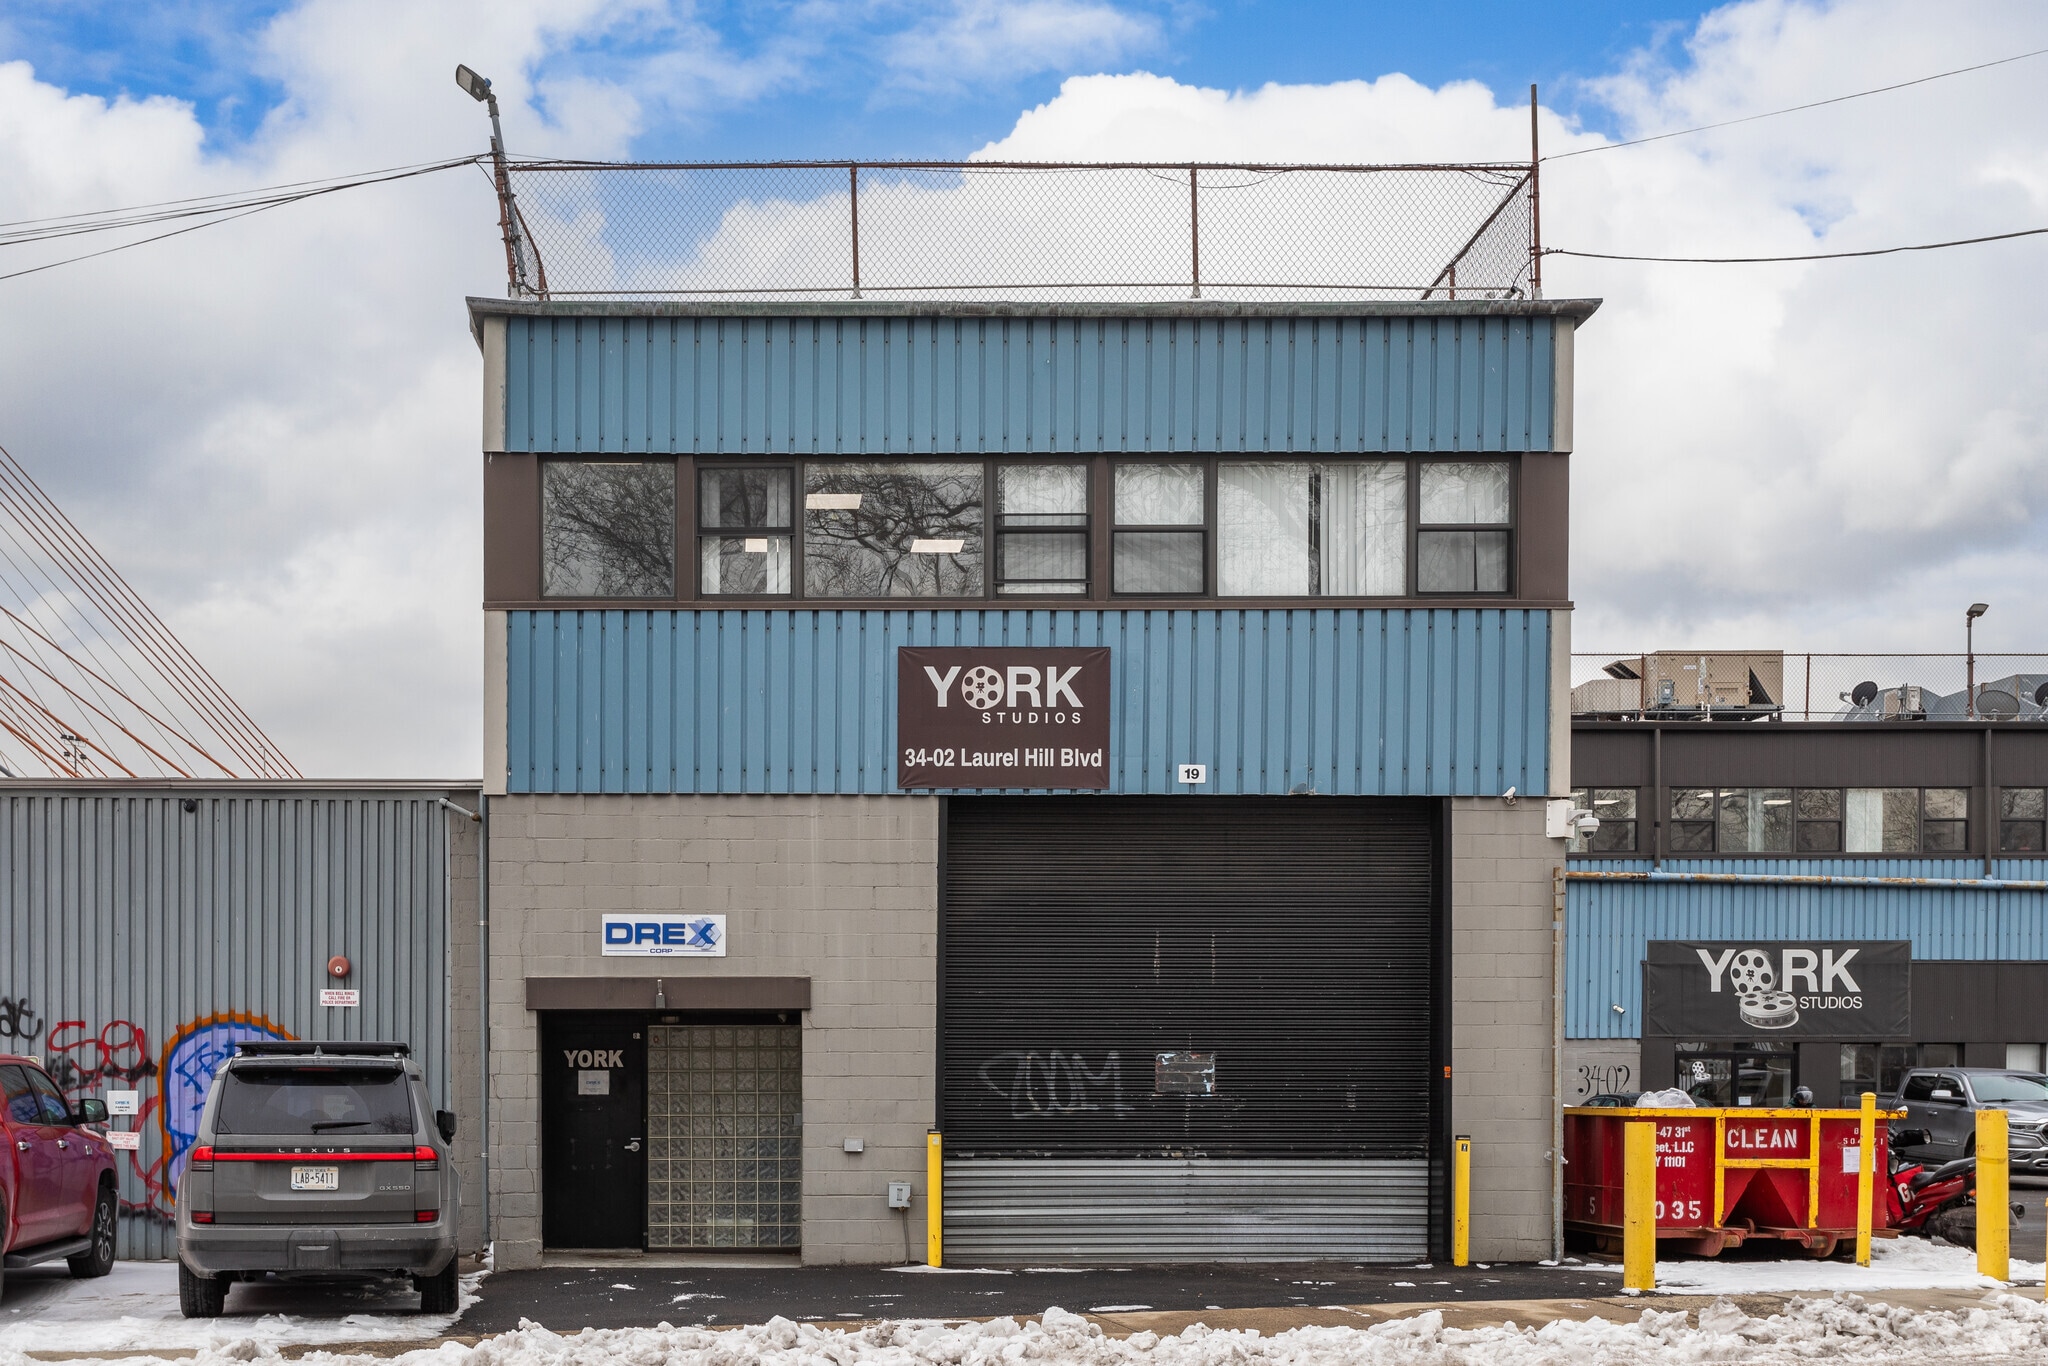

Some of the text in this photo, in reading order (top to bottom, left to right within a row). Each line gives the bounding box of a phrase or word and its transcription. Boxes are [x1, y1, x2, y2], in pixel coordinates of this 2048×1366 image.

[923, 665, 1084, 710] YORK
[981, 712, 1082, 724] STUDIOS
[905, 748, 1102, 767] 34-02 Laurel Hill Blvd
[1184, 768, 1200, 780] 19
[605, 922, 717, 946] DREX
[1696, 948, 1862, 994] YORK
[1799, 996, 1863, 1010] STUDIOS
[564, 1049, 624, 1068] YORK
[1577, 1064, 1631, 1096] 34-02
[1674, 1125, 1691, 1138] 31st
[1727, 1128, 1798, 1149] CLEAN
[1664, 1156, 1686, 1167] 11101
